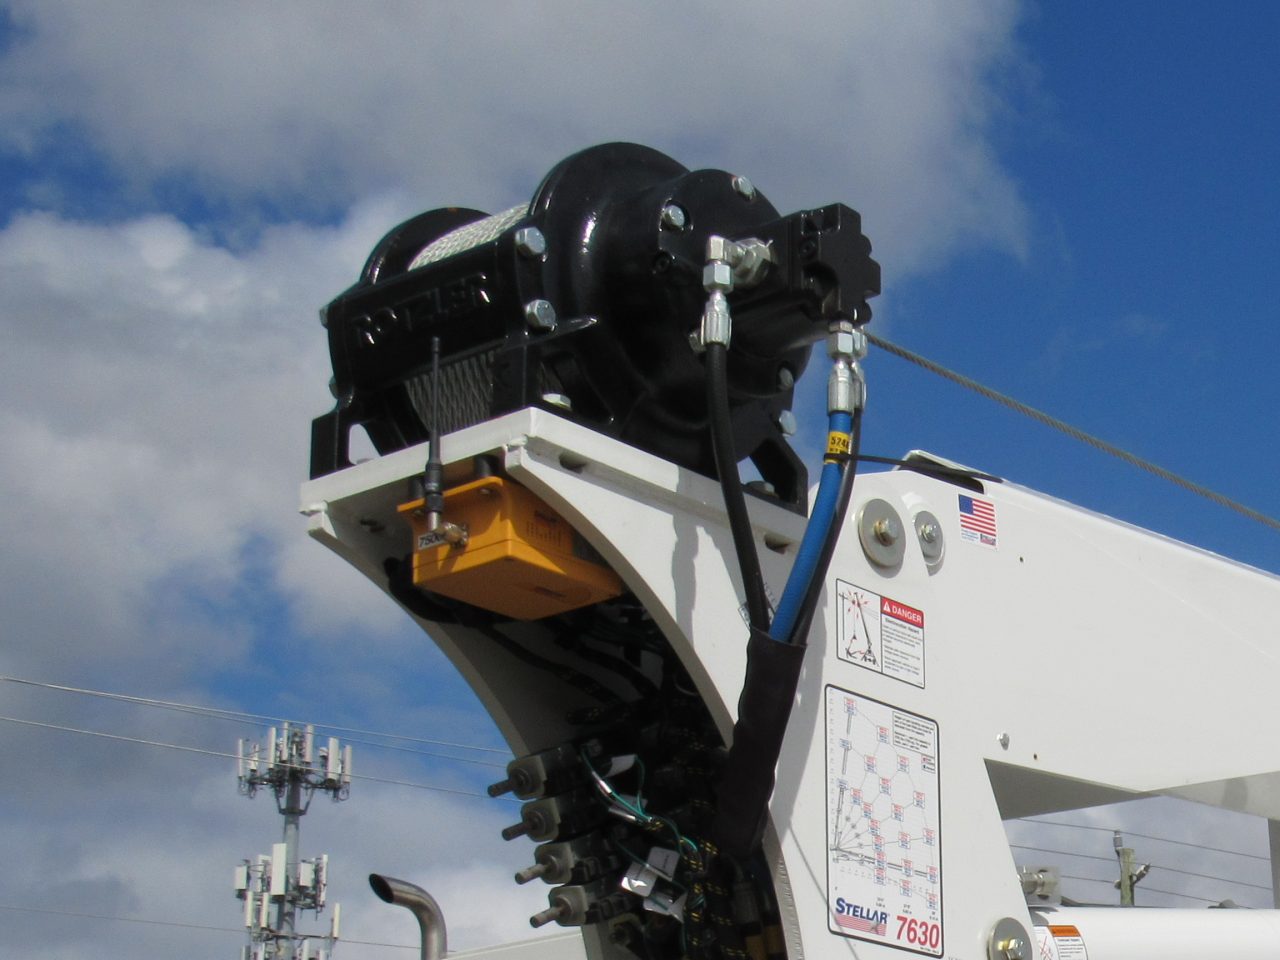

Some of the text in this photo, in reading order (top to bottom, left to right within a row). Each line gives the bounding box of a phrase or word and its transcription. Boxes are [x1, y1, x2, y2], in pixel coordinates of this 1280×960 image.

[892, 605, 922, 623] DANGER
[835, 897, 888, 925] STELLAR
[896, 915, 940, 949] 7630
